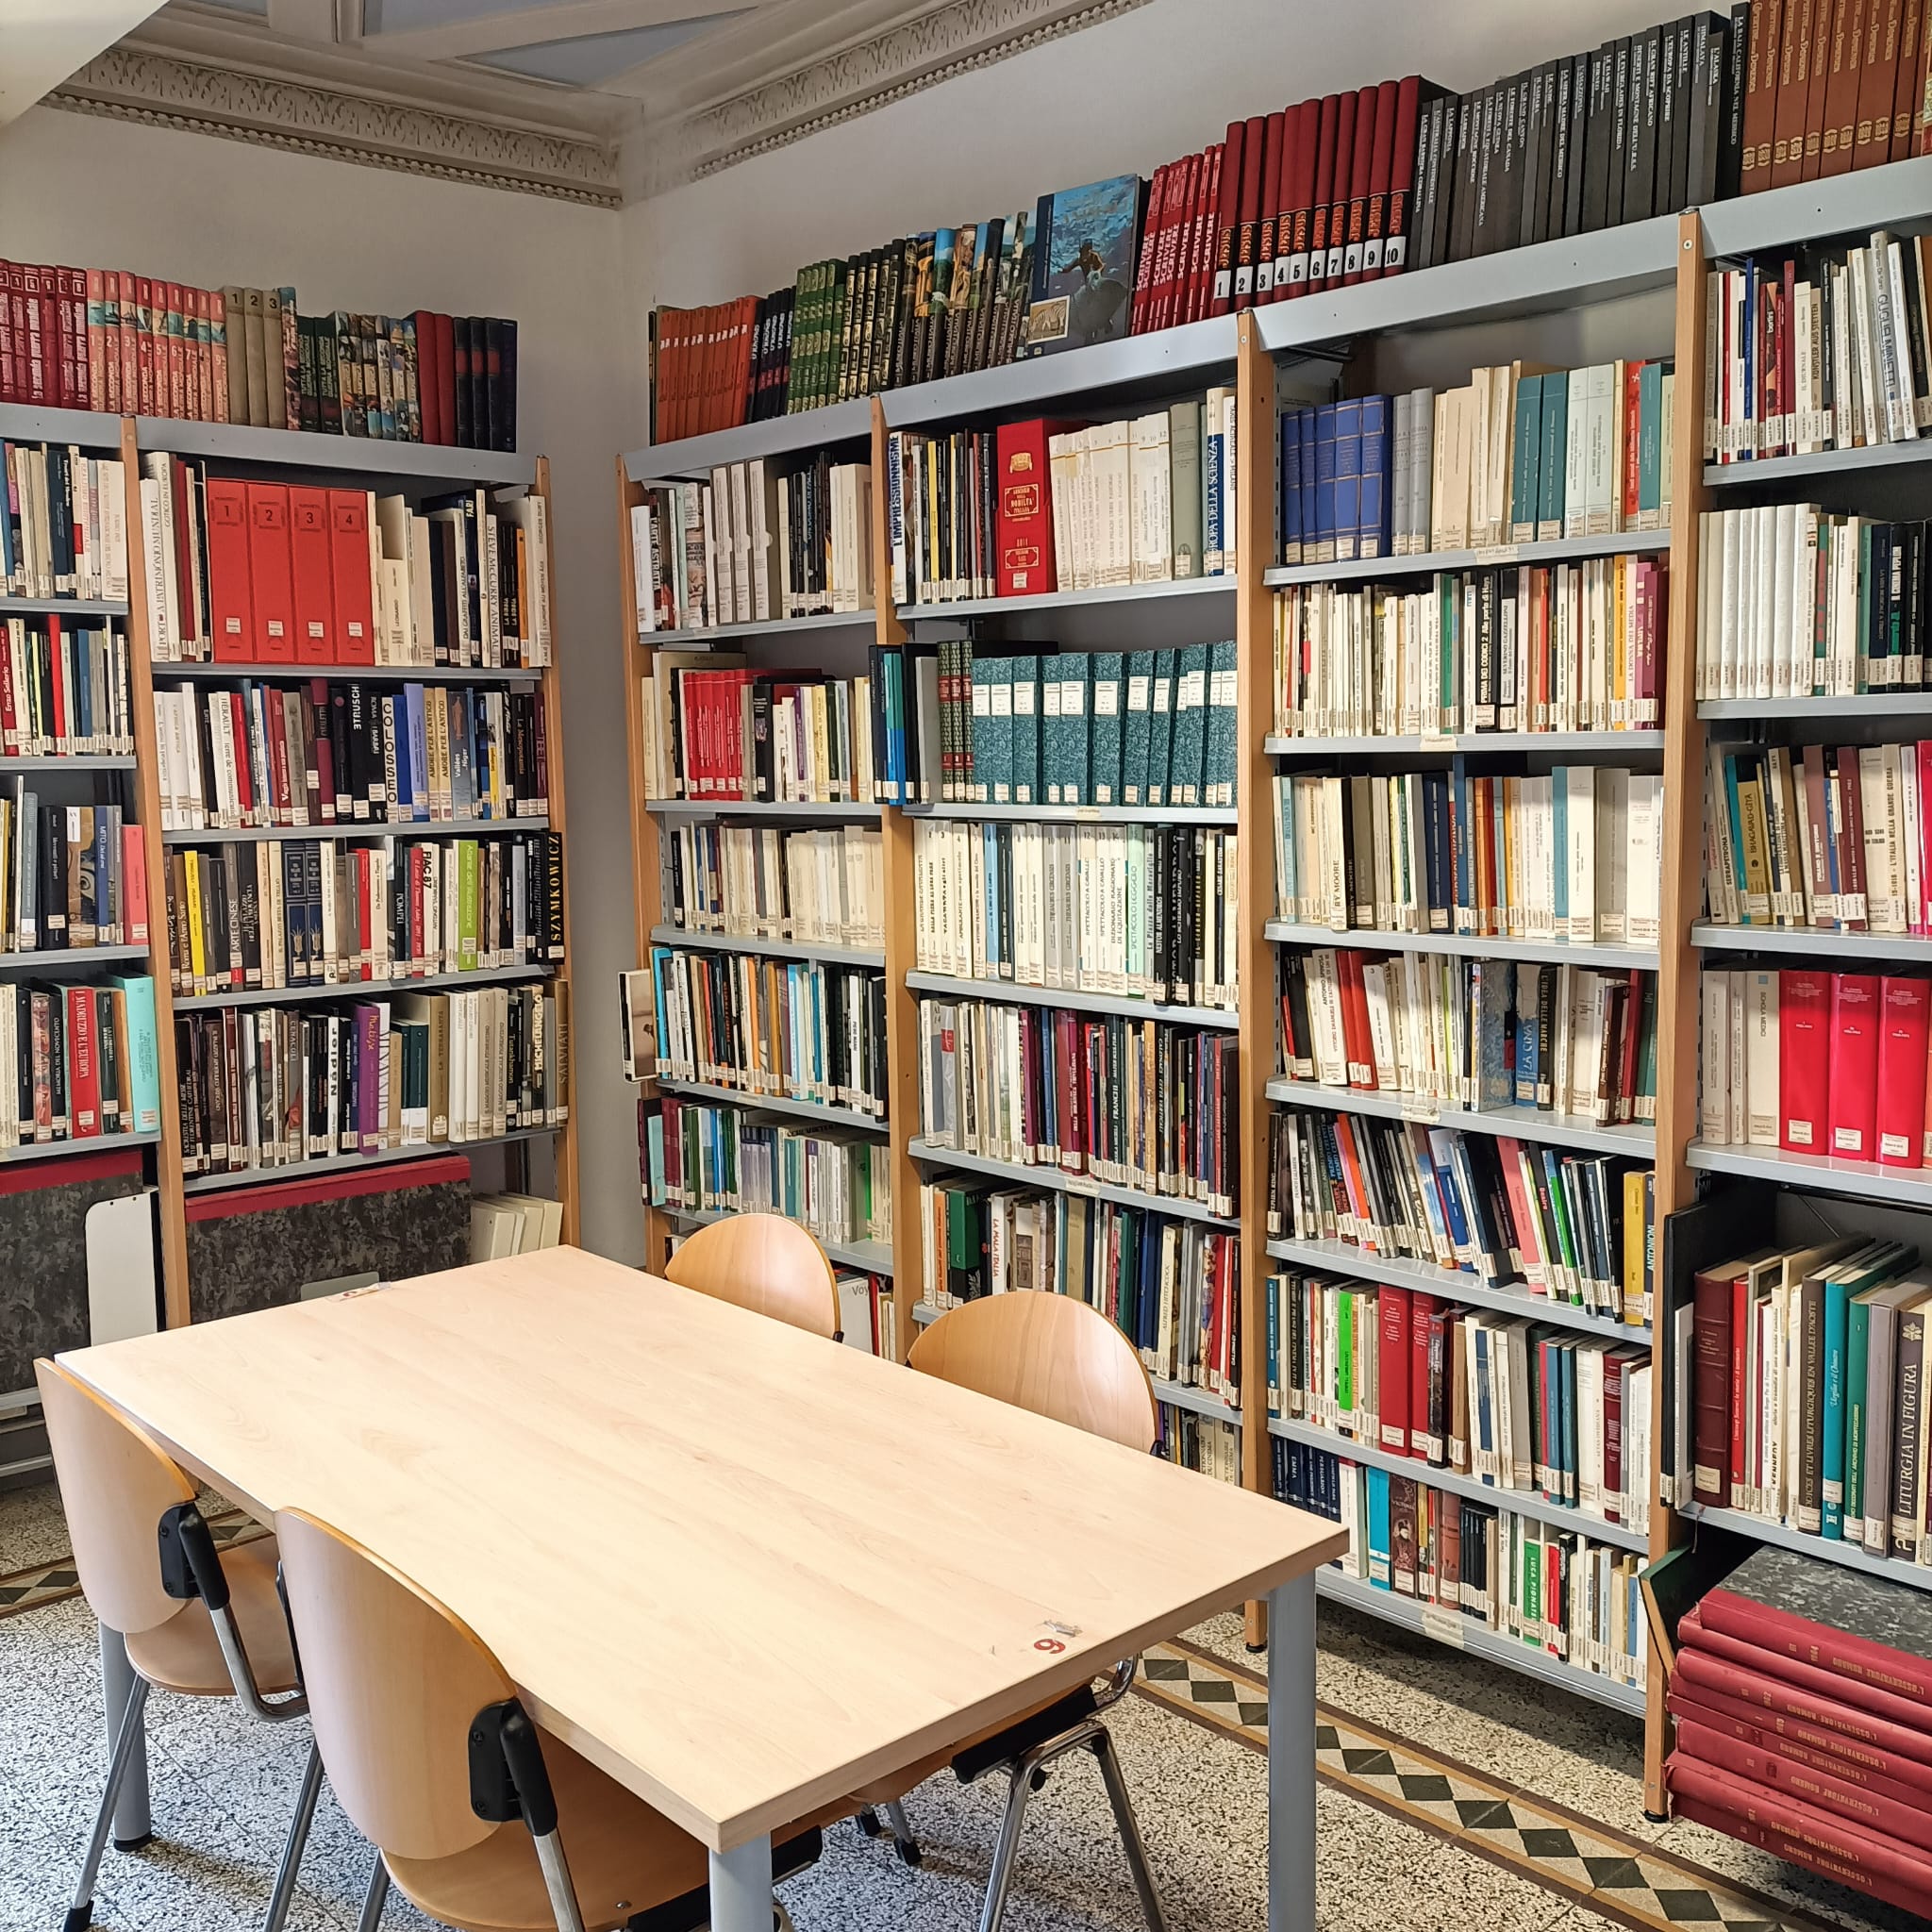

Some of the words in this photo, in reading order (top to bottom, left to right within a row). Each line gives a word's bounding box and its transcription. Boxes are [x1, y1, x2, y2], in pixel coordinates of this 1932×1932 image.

[1166, 222, 1180, 280] SCRIVERE
[1177, 221, 1191, 279] SCRIVERE
[1191, 213, 1204, 273] SCRIVERE
[1203, 211, 1215, 272] SCRIVERE
[1137, 235, 1149, 291] SCRIVERE
[1153, 228, 1166, 286] SCRIVERE
[1160, 226, 1173, 283] SCRIVERE
[1348, 255, 1355, 269] 8
[1368, 251, 1374, 264] 9
[1387, 248, 1398, 263] 10
[1277, 268, 1285, 282] 4
[1293, 264, 1301, 278] 5
[1312, 261, 1320, 275] 6
[1331, 258, 1339, 273] 7
[1217, 281, 1223, 296] 1
[1238, 278, 1245, 291] 2
[1259, 275, 1266, 289] 3
[232, 293, 238, 304] 1
[250, 294, 258, 306] 2
[269, 297, 277, 308] 3
[1208, 441, 1218, 485] SCIENZA
[224, 505, 230, 517] 1
[465, 500, 475, 518] FARI
[1208, 487, 1217, 520] DELLA
[265, 508, 274, 521] 2
[306, 511, 313, 524] 3
[345, 514, 353, 525] 4
[487, 525, 497, 557] STEVE
[650, 517, 659, 544] L'ARTE
[651, 548, 661, 591] ASTRATTA
[491, 609, 499, 650] ANIMAL
[383, 703, 396, 803] COLOSSEO
[424, 851, 432, 874] FIAC
[1721, 836, 1733, 886] SERRAPETRONA
[424, 875, 432, 889] 87
[548, 836, 561, 941] SZYMKOWICZ
[228, 898, 240, 929] CINESE
[396, 893, 405, 924] POMPEI
[230, 930, 240, 951] ARTE
[181, 950, 190, 969] Roma
[992, 1218, 999, 1228] LA
[1647, 1224, 1656, 1271] ANTONIONI
[1903, 1364, 1917, 1420] FIGURA
[1902, 1423, 1915, 1443] IN
[1899, 1443, 1914, 1515] LITURGIA
